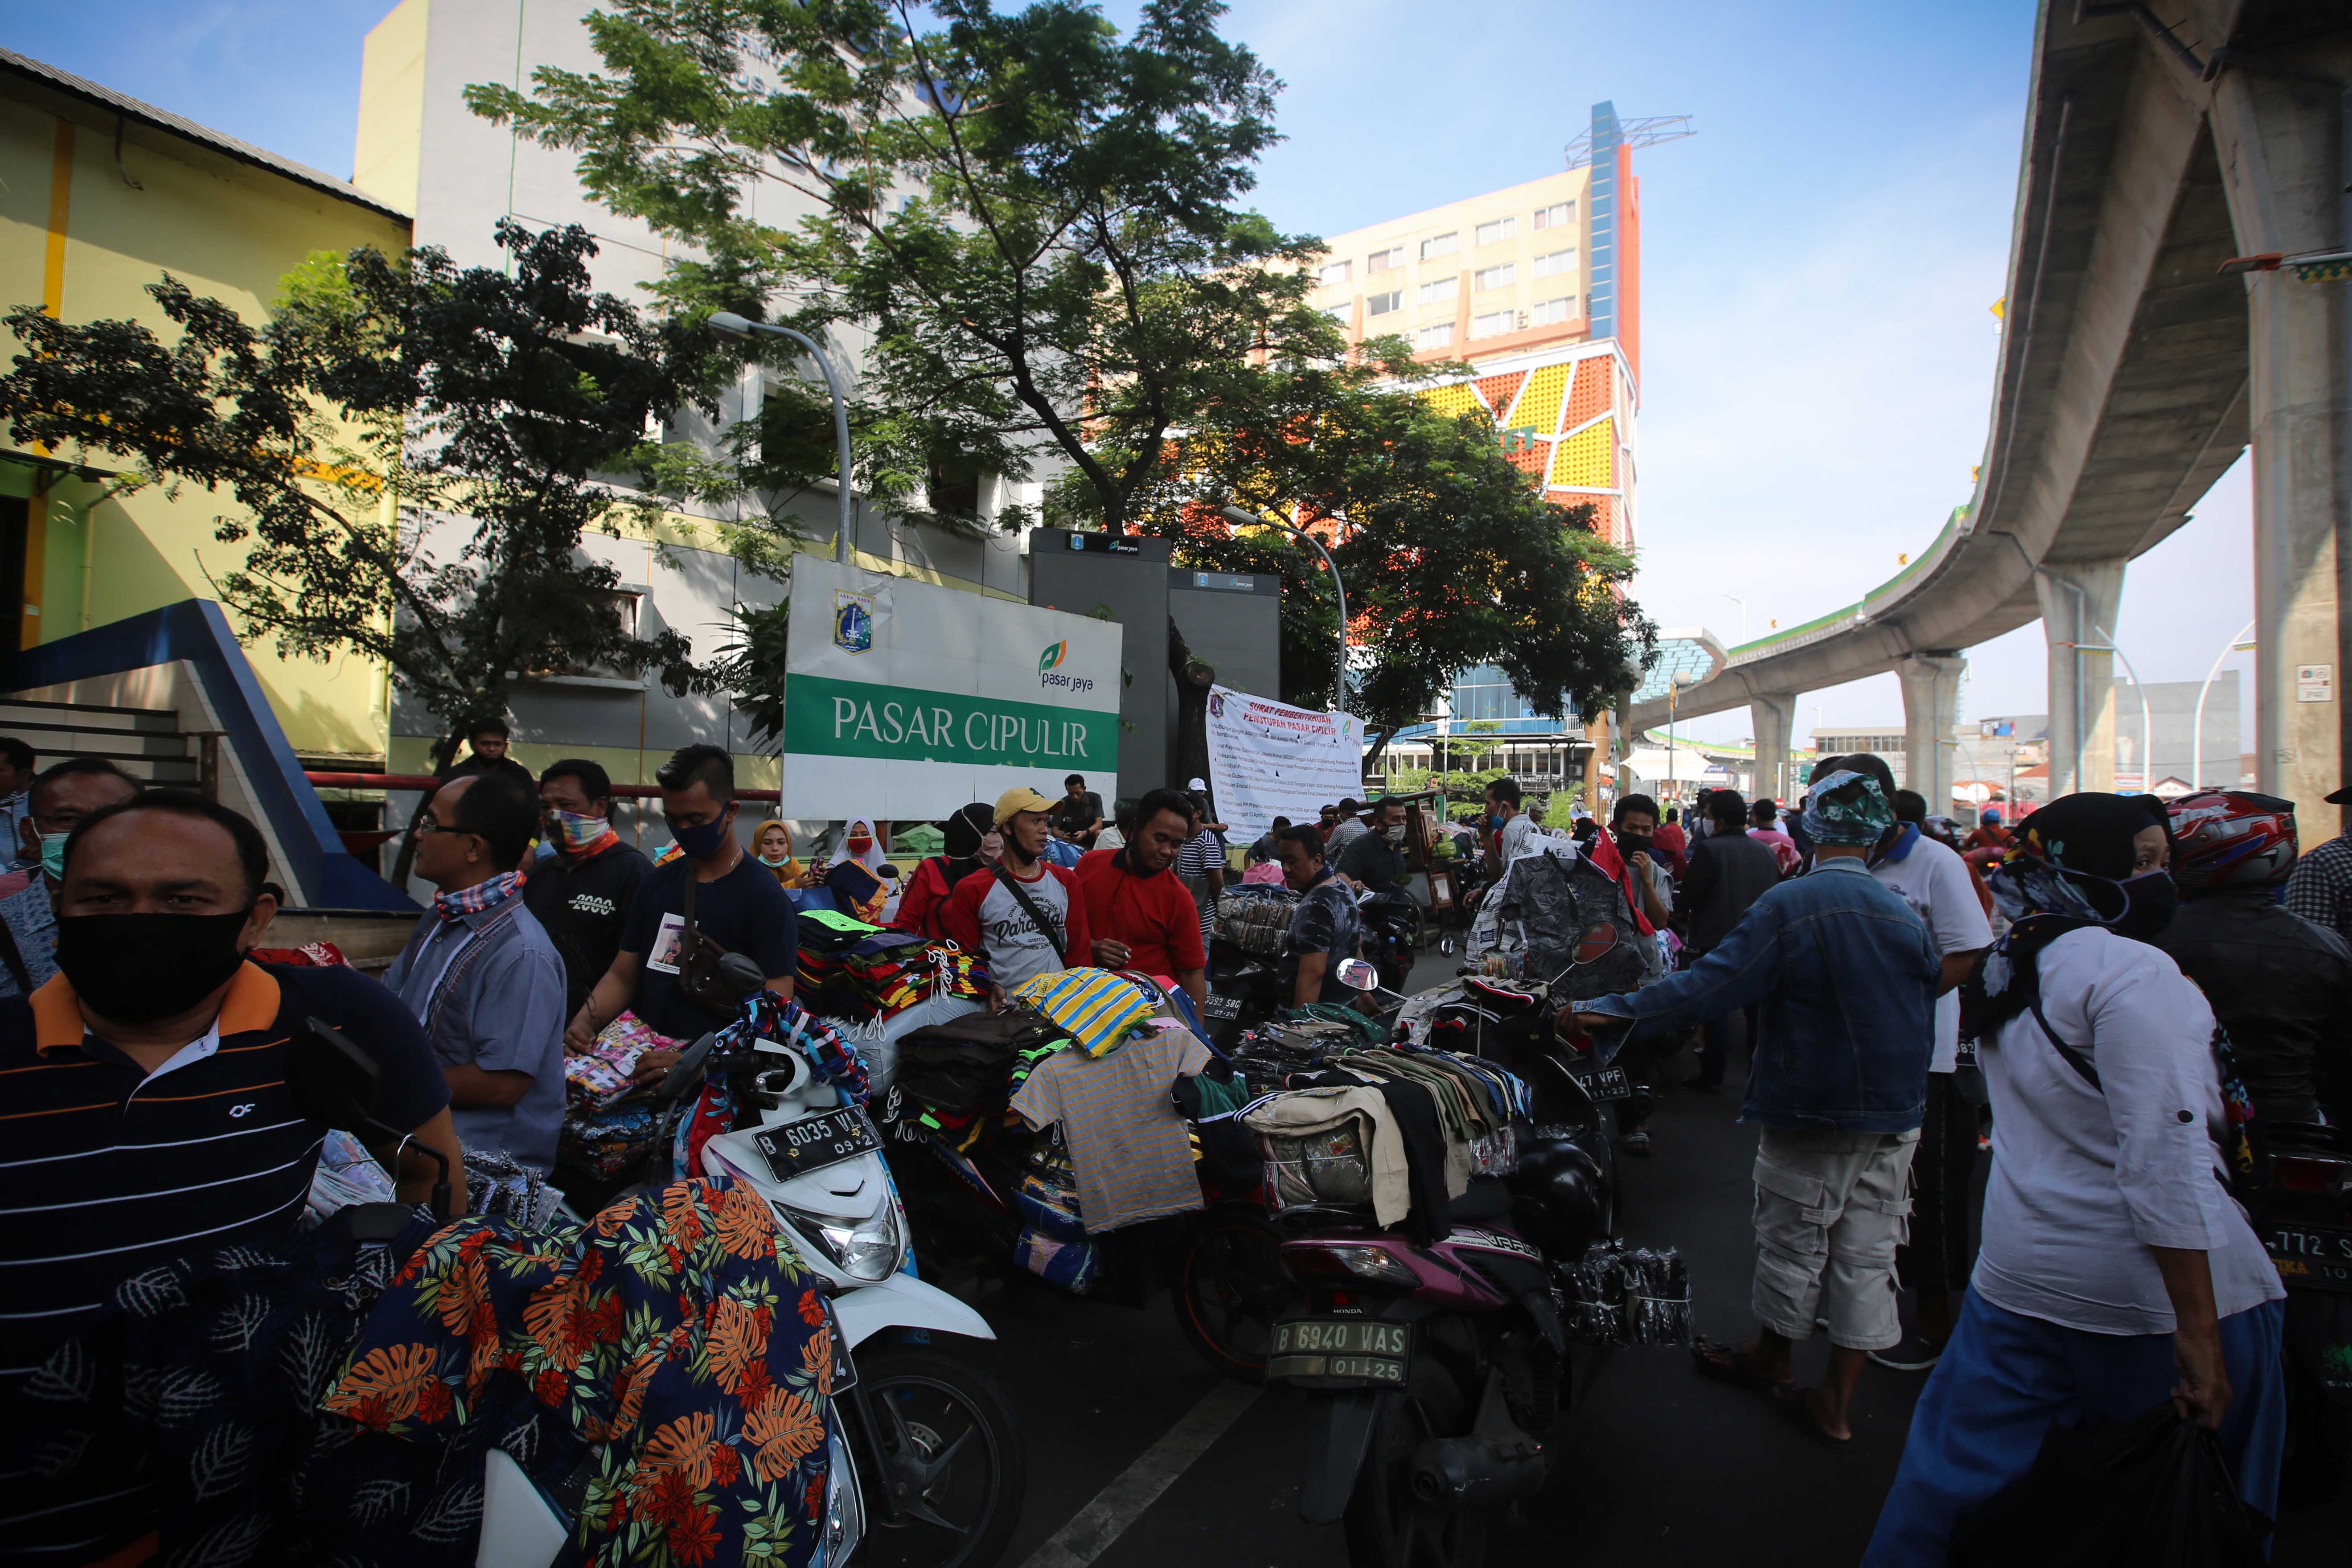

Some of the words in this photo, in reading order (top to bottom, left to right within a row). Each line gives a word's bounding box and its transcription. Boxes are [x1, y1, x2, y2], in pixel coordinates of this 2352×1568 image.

[1043, 673, 1071, 688] pasar
[1071, 677, 1093, 692] jaya
[1244, 713, 1286, 728] PENUTUPAN
[1288, 721, 1310, 733] PASAR
[1312, 725, 1336, 735] CIPULIR
[1249, 702, 1274, 714] SURAT
[1274, 708, 1332, 724] PEMBERITAHUAN
[832, 696, 955, 748] PASAR
[965, 711, 1088, 757] CIPULIR
[572, 894, 612, 915] 2000
[1598, 1070, 1621, 1083] VPF
[759, 1137, 776, 1155] B
[786, 1120, 833, 1146] 6035
[2265, 1231, 2325, 1256] 772
[1278, 1328, 1289, 1351] B
[1298, 1325, 1347, 1350] 6940
[1361, 1326, 1404, 1353] VAS
